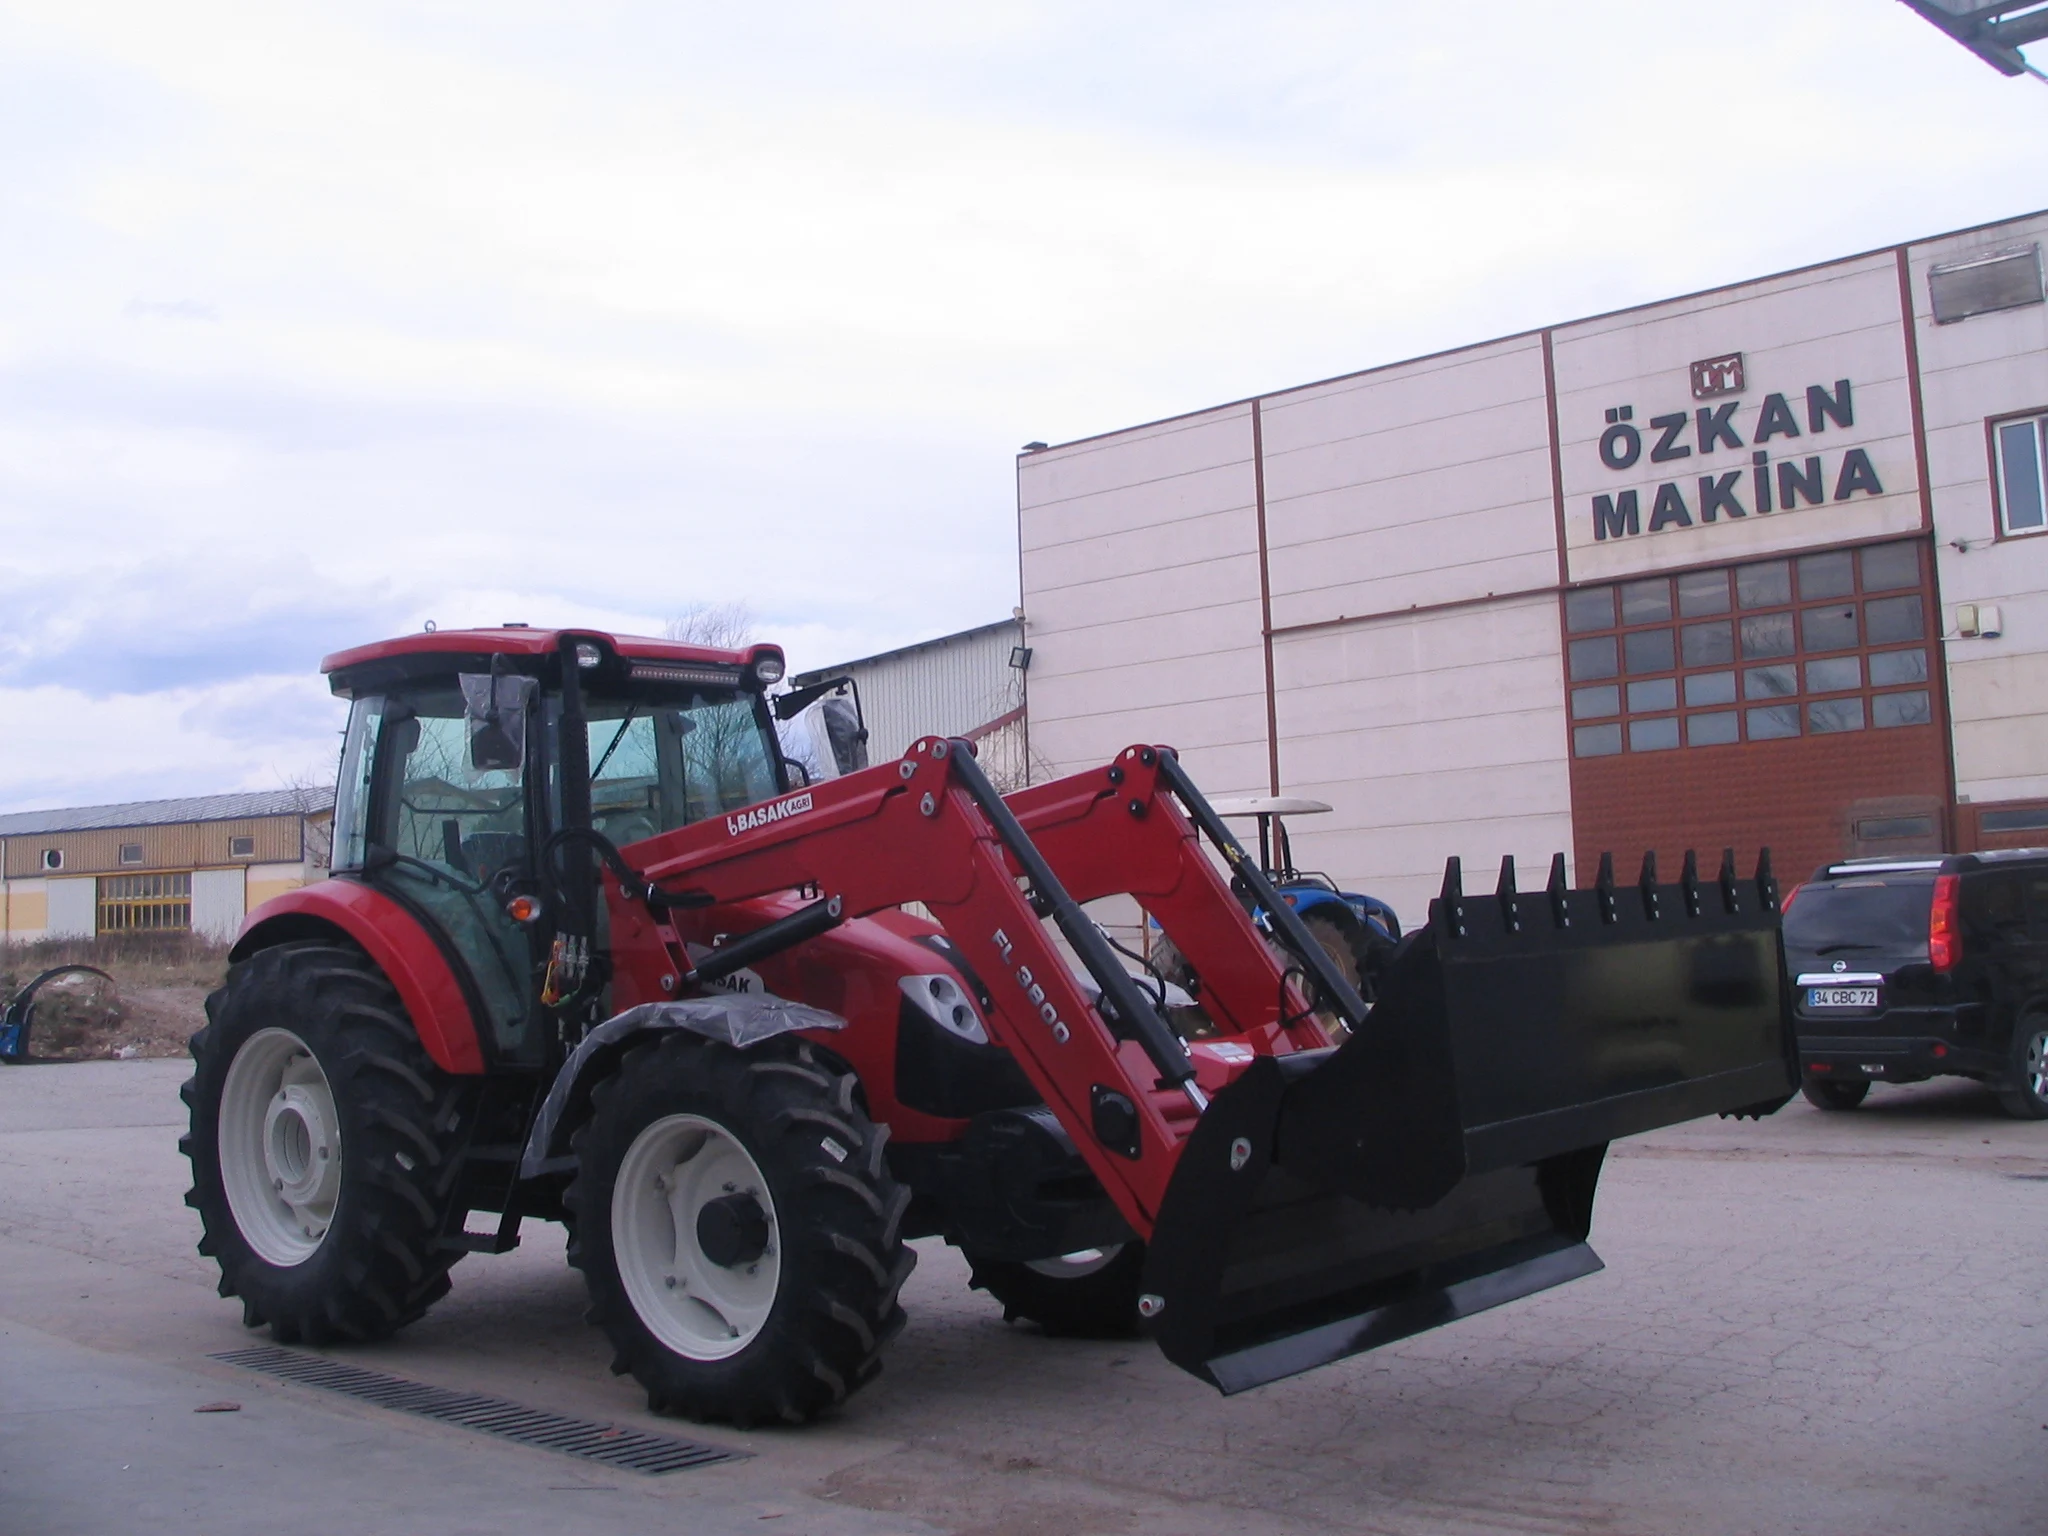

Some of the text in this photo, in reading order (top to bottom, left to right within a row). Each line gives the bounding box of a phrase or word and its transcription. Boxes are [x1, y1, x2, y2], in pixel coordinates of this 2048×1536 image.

[1599, 379, 1854, 470] ÖZKAN
[1592, 448, 1883, 541] MAKİNA
[790, 797, 811, 812] AGRI
[991, 928, 1070, 1043] FL 3800
[1815, 990, 1875, 1004] 34 CBC 72
